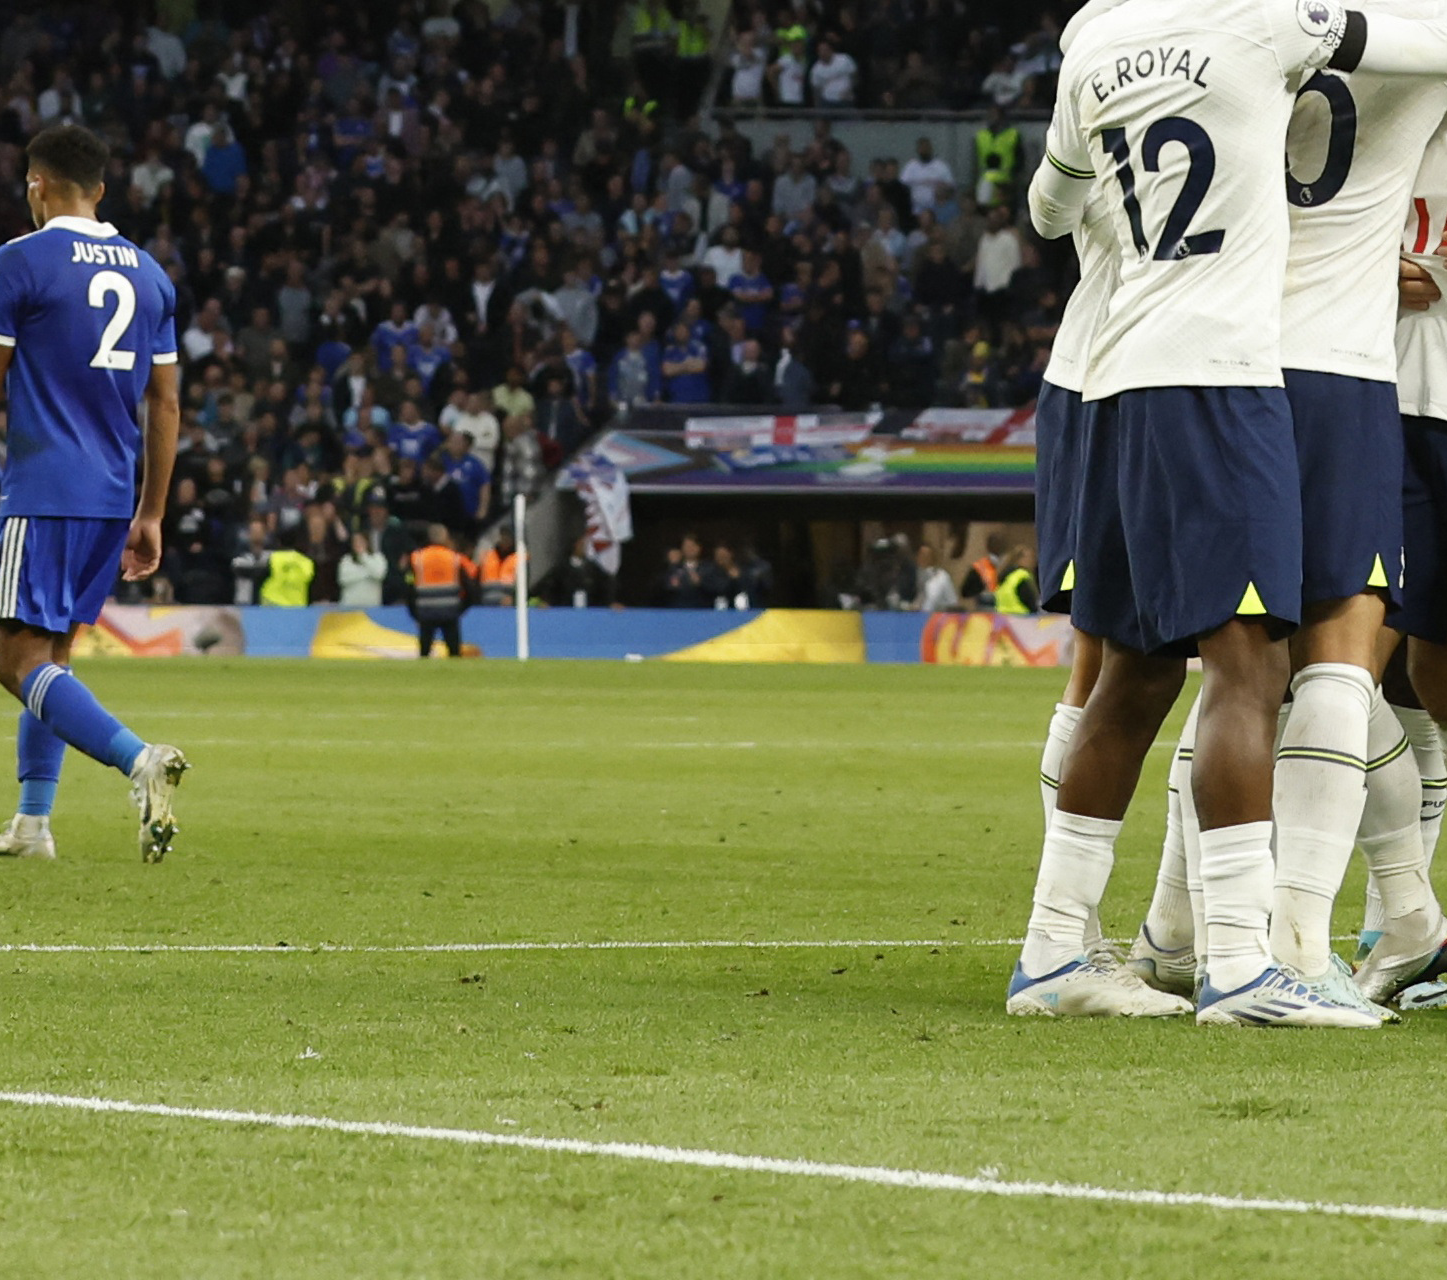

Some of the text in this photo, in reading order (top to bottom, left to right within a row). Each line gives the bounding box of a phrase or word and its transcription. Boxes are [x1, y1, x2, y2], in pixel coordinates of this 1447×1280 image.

[1092, 46, 1211, 103] E.ROYAL
[1101, 116, 1226, 261] 12
[72, 241, 139, 268] JUSTIN
[88, 270, 136, 370] 2
